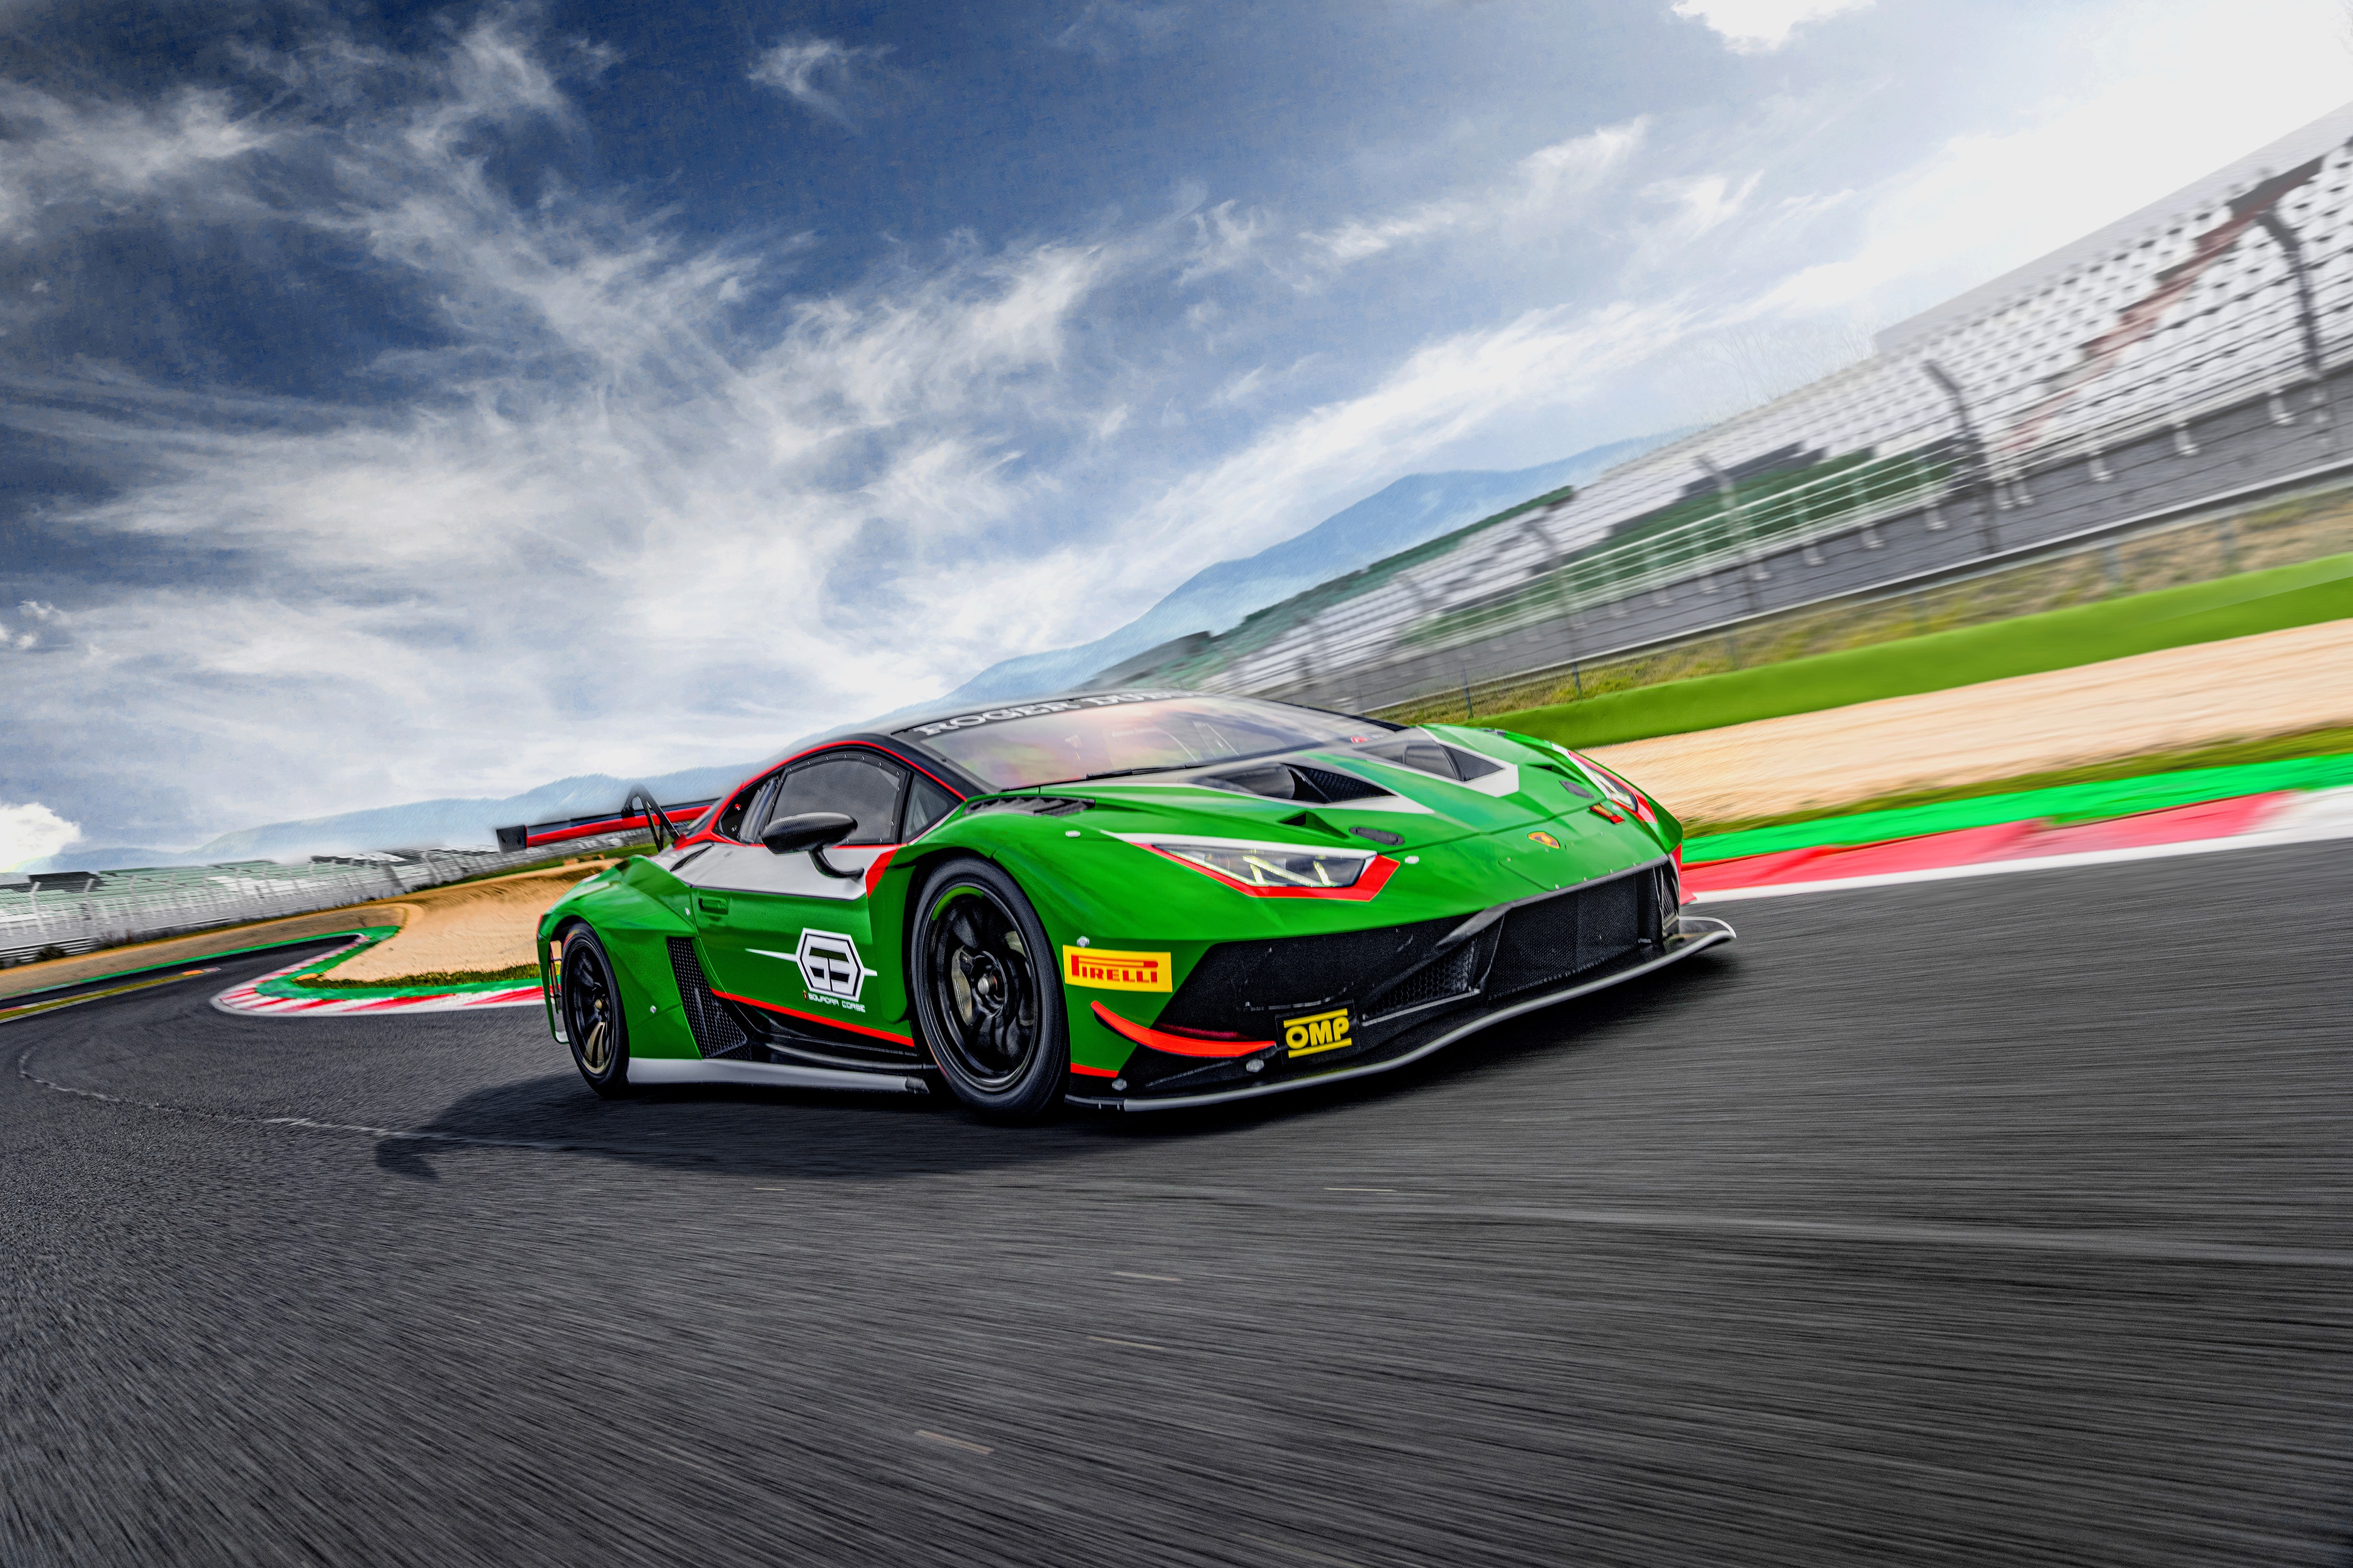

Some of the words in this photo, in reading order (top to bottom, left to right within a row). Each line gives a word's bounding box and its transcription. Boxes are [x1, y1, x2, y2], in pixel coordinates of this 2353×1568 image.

[914, 702, 1082, 735] ROGER
[1071, 953, 1158, 984] PIRELLI
[808, 992, 839, 1006] SQUADRA
[841, 1000, 866, 1013] CORSE
[1286, 1016, 1349, 1050] OMP
